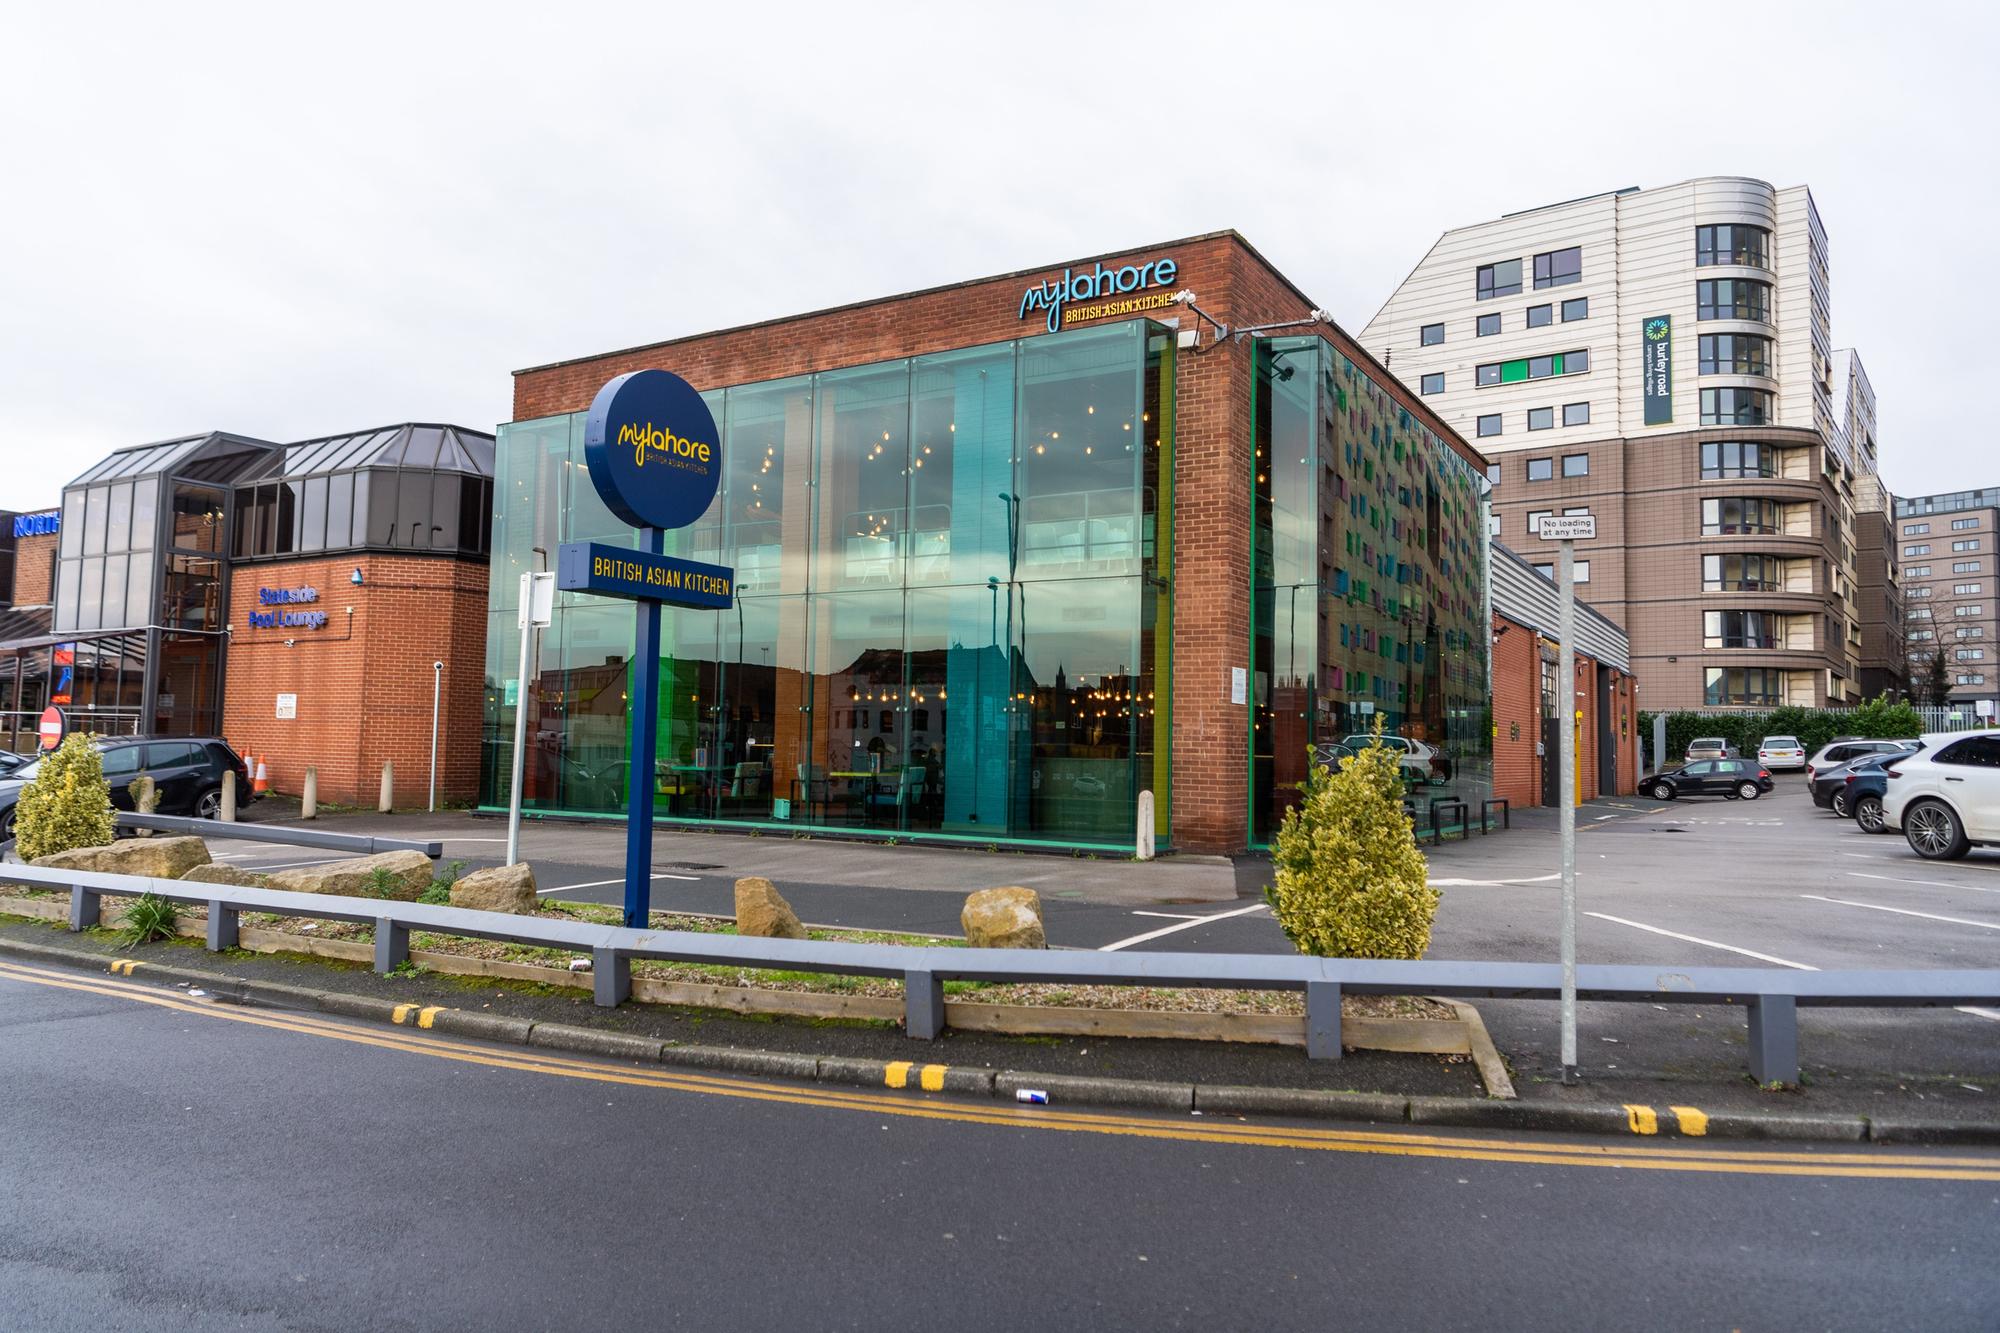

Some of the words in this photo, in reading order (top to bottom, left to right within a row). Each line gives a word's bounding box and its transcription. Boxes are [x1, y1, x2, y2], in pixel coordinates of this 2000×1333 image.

[1065, 306, 1102, 323] BRITISH
[1104, 300, 1133, 316] ASIAN
[1654, 342, 1669, 372] burley
[1646, 364, 1654, 377] living
[1646, 377, 1654, 396] villages
[1657, 374, 1669, 396] road
[1559, 519, 1591, 527] loading
[594, 556, 643, 582] BRITISH
[646, 566, 681, 588] ASIAN
[684, 572, 729, 596] KITCHEN
[259, 586, 318, 606] Stateside
[248, 610, 275, 628] Pool
[278, 610, 327, 631] Lounge
